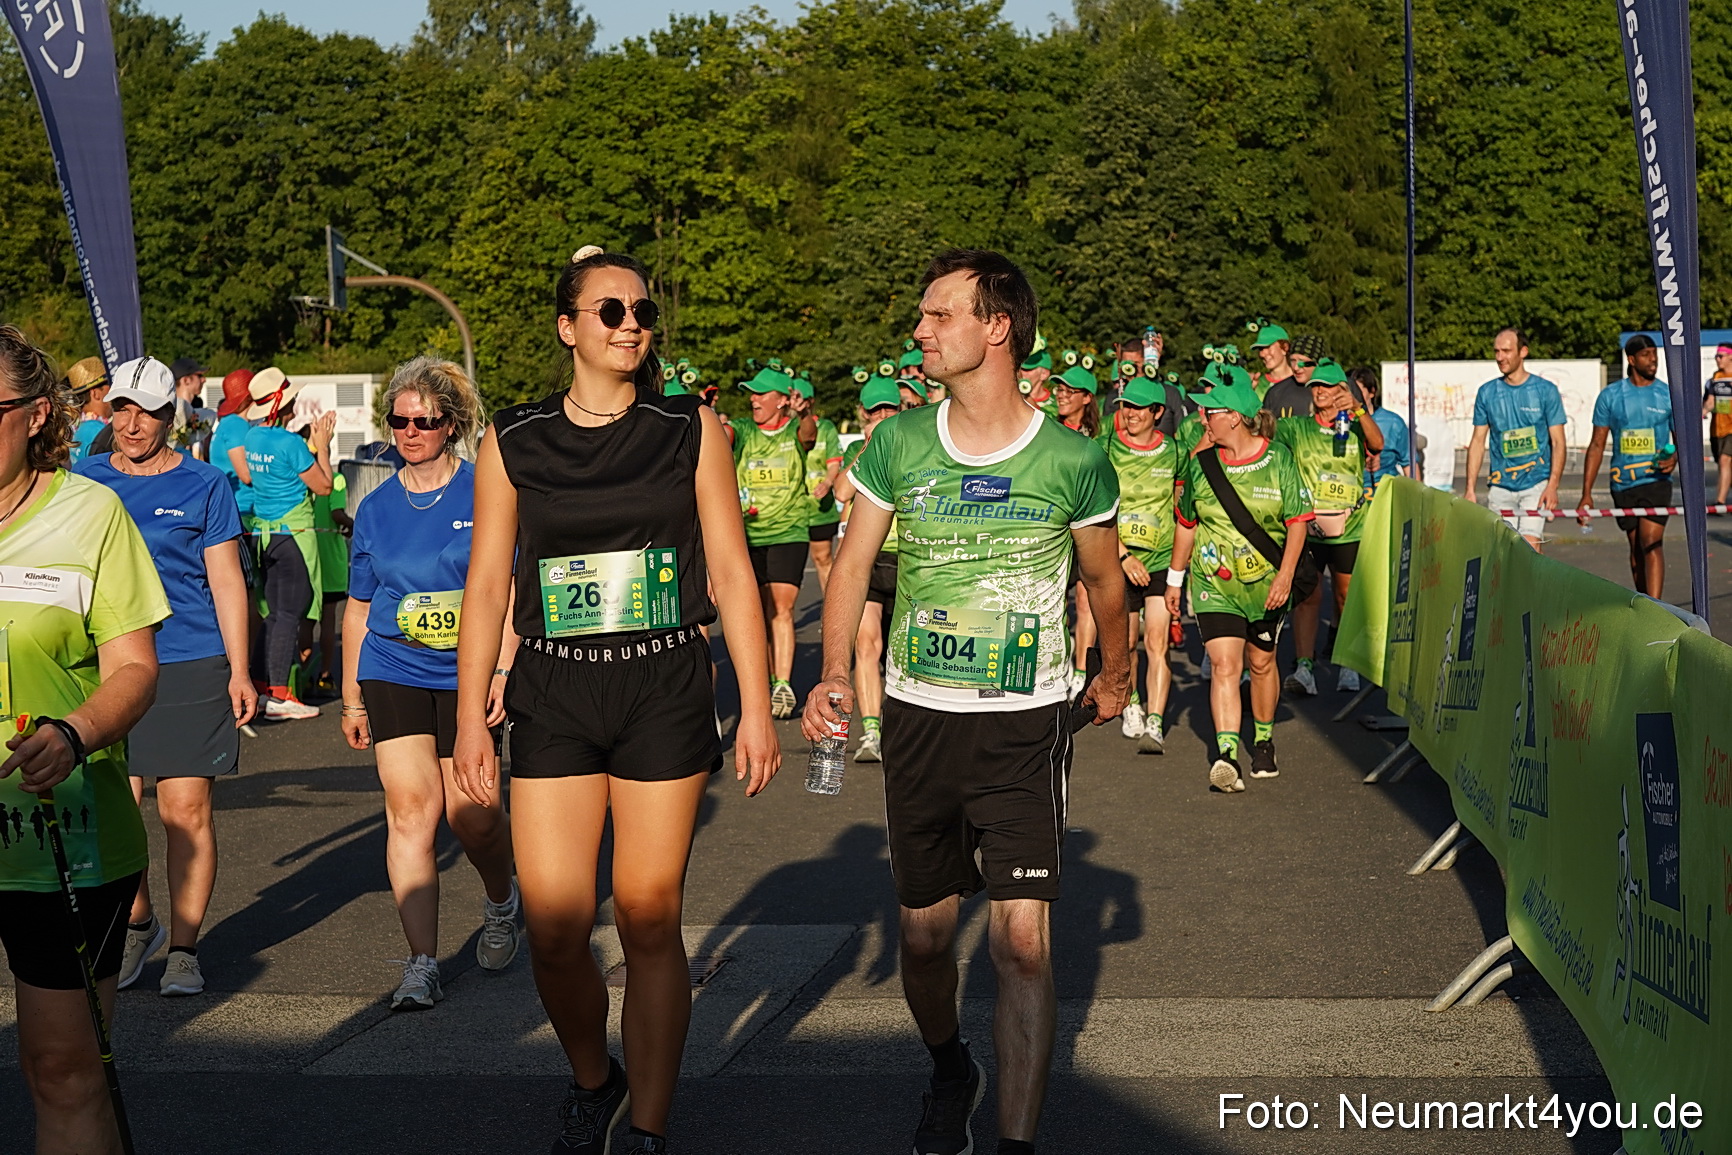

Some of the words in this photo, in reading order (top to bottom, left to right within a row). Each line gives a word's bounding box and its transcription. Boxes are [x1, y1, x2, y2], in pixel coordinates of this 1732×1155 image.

[1508, 437, 1532, 448] 1925
[1626, 437, 1649, 447] 1920
[759, 469, 773, 480] 51
[918, 467, 949, 482] Jahre
[971, 481, 1008, 495] Fischer
[1329, 483, 1344, 495] 96
[933, 496, 1056, 522] firmenlauf
[932, 515, 985, 526] neumarkt
[1130, 523, 1147, 536] 86
[904, 530, 969, 546] Gesunde
[976, 533, 1040, 546] Firmen
[929, 547, 979, 561] laufen
[988, 543, 1047, 566] lger!
[22, 580, 59, 589] Neumarkt
[24, 572, 61, 583] Klinikum
[548, 594, 559, 622] RUN
[632, 582, 643, 619] 2022
[416, 610, 456, 631] 439
[558, 612, 583, 621] Fuchs
[534, 633, 613, 663] ARMOUR
[621, 630, 687, 660] UNDER
[911, 636, 919, 663] RUN
[926, 631, 977, 662] 304
[916, 655, 941, 670] Zibulla
[941, 661, 987, 675] Sebastian
[986, 643, 1000, 679] 2022
[1646, 772, 1675, 806] Fischer
[1653, 811, 1674, 827] AUTOMOBILE
[1025, 868, 1049, 878] JAKO
[1638, 878, 1713, 1020] firmenlauf
[1634, 996, 1670, 1044] neumarkt
